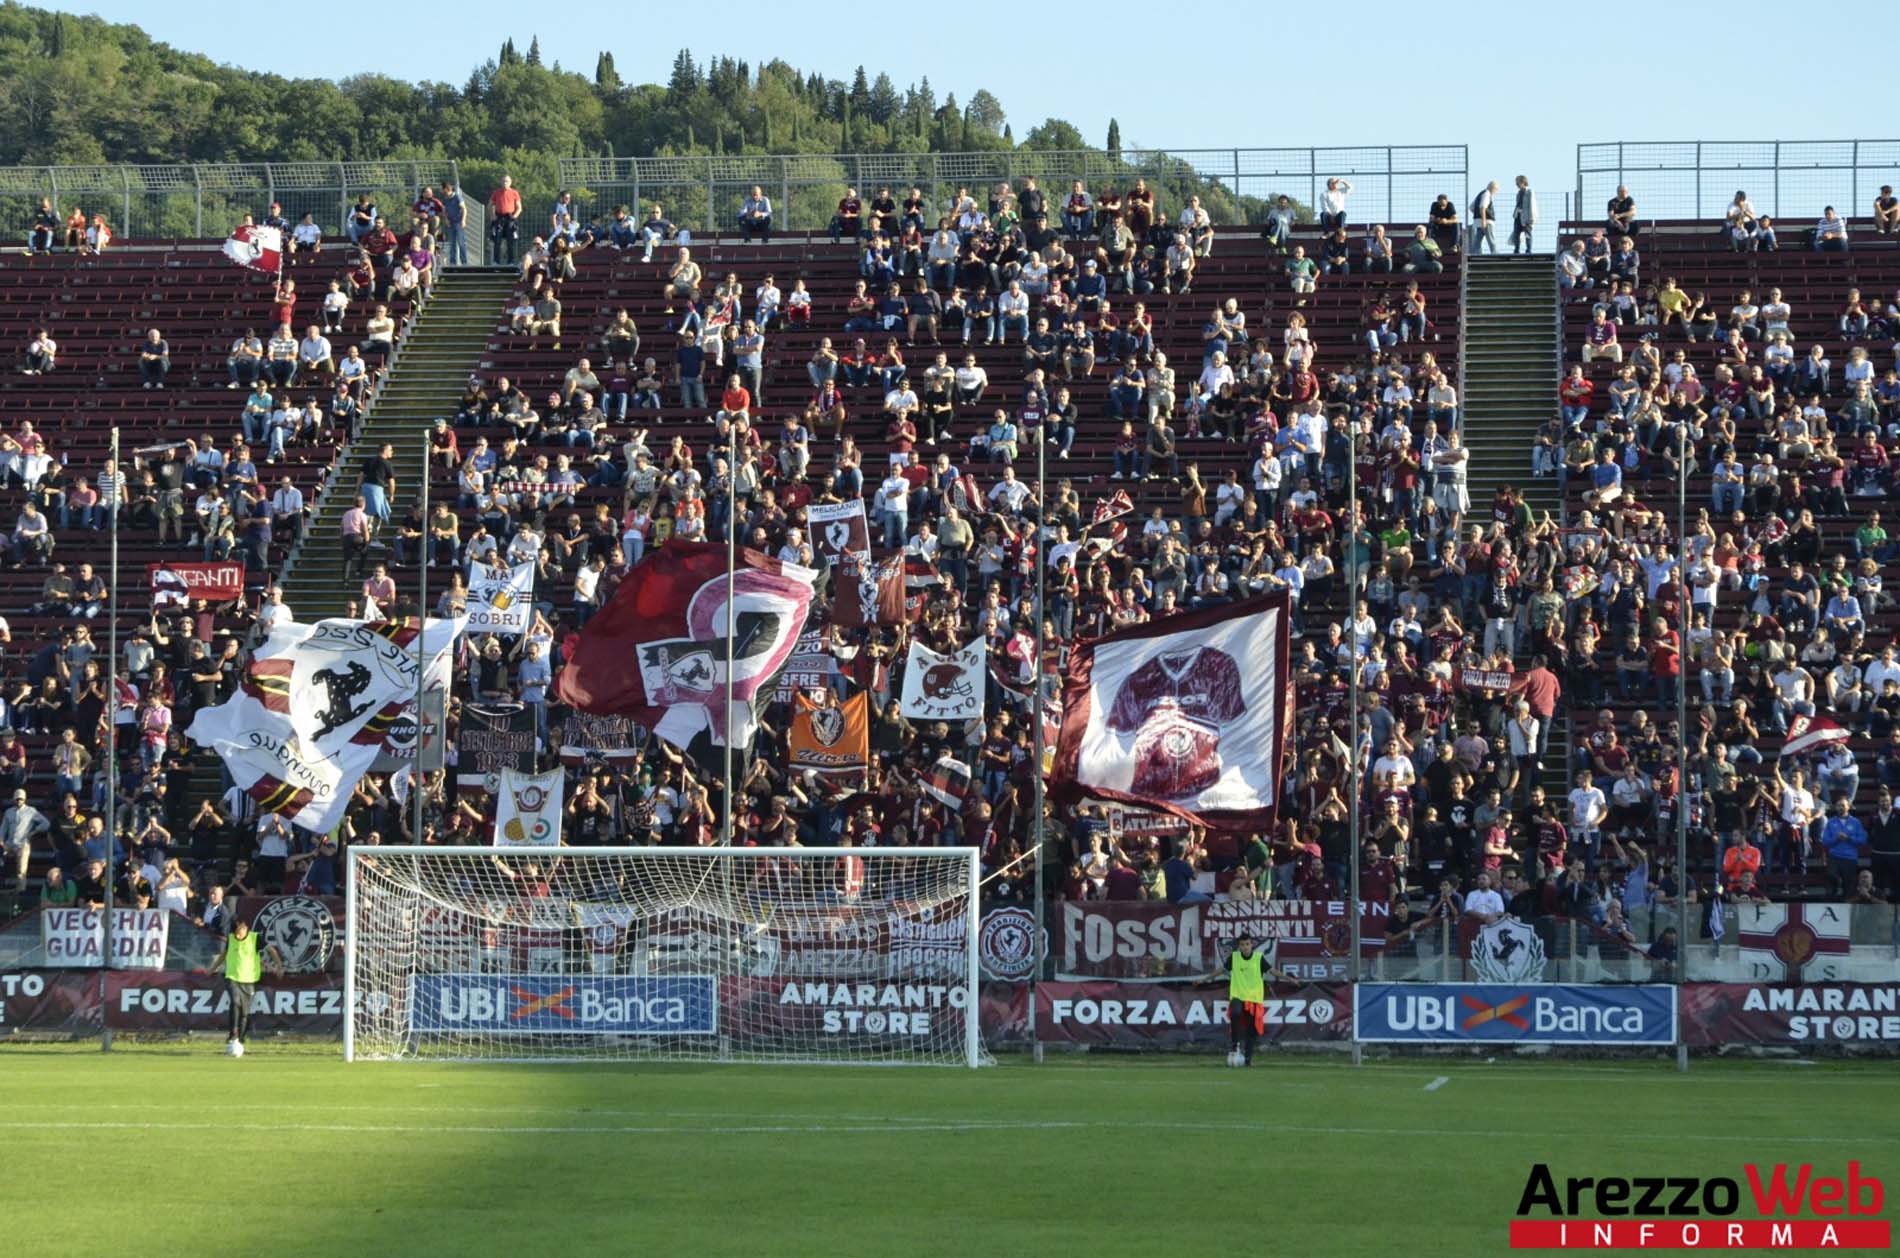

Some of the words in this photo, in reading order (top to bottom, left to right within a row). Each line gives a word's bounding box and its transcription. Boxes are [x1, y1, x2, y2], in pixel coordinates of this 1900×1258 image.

[468, 612, 521, 626] SOBRI
[259, 897, 333, 928] AREZZO
[1207, 900, 1312, 918] ASSENTI
[1063, 902, 1203, 973] FOSSA
[1203, 919, 1316, 938] PRESENTI
[440, 987, 505, 1022] UBI
[581, 988, 685, 1024] Banca
[779, 982, 970, 1009] AMARANTO
[1742, 987, 1900, 1012] AMARAN
[823, 1010, 931, 1035] STORE
[1053, 1000, 1178, 1025] FORZA
[1184, 999, 1334, 1025] ARZZO
[1386, 996, 1456, 1032] UBI
[1535, 997, 1643, 1034] Banca
[1788, 1015, 1900, 1040] STORE
